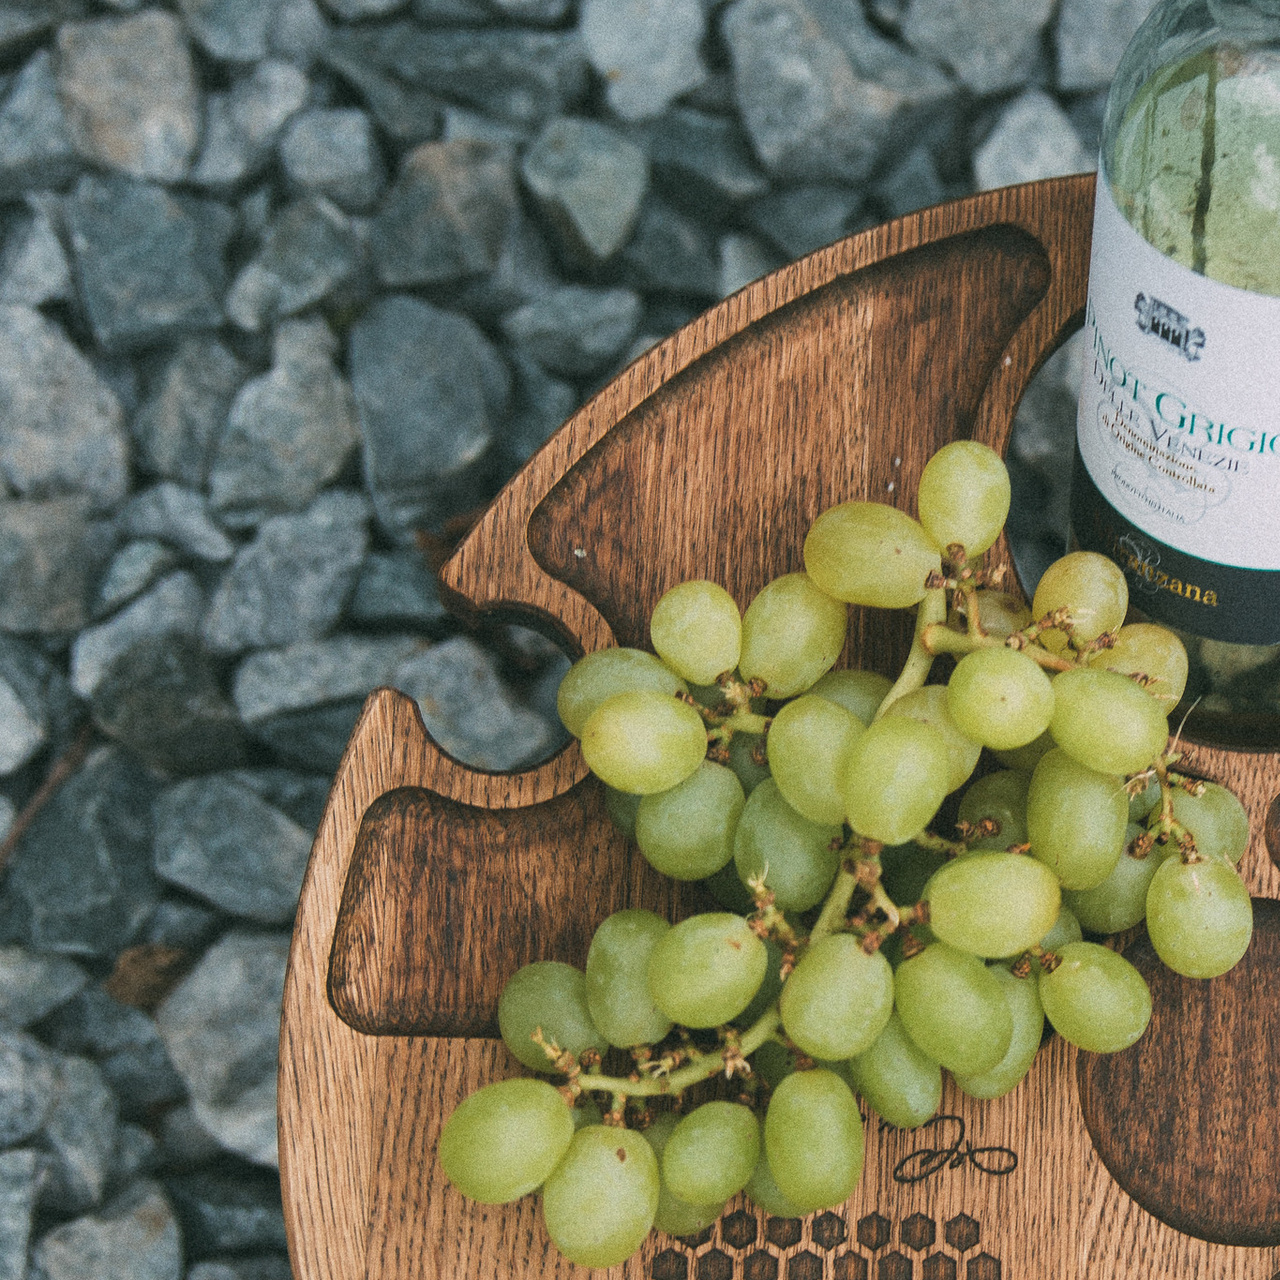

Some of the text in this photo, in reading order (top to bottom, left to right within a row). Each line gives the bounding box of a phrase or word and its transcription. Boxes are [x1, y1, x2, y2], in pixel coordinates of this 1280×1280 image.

[1087, 295, 1147, 401] PINOT
[1147, 455, 1216, 494] Controllata
[1150, 419, 1251, 476] VENEZIE
